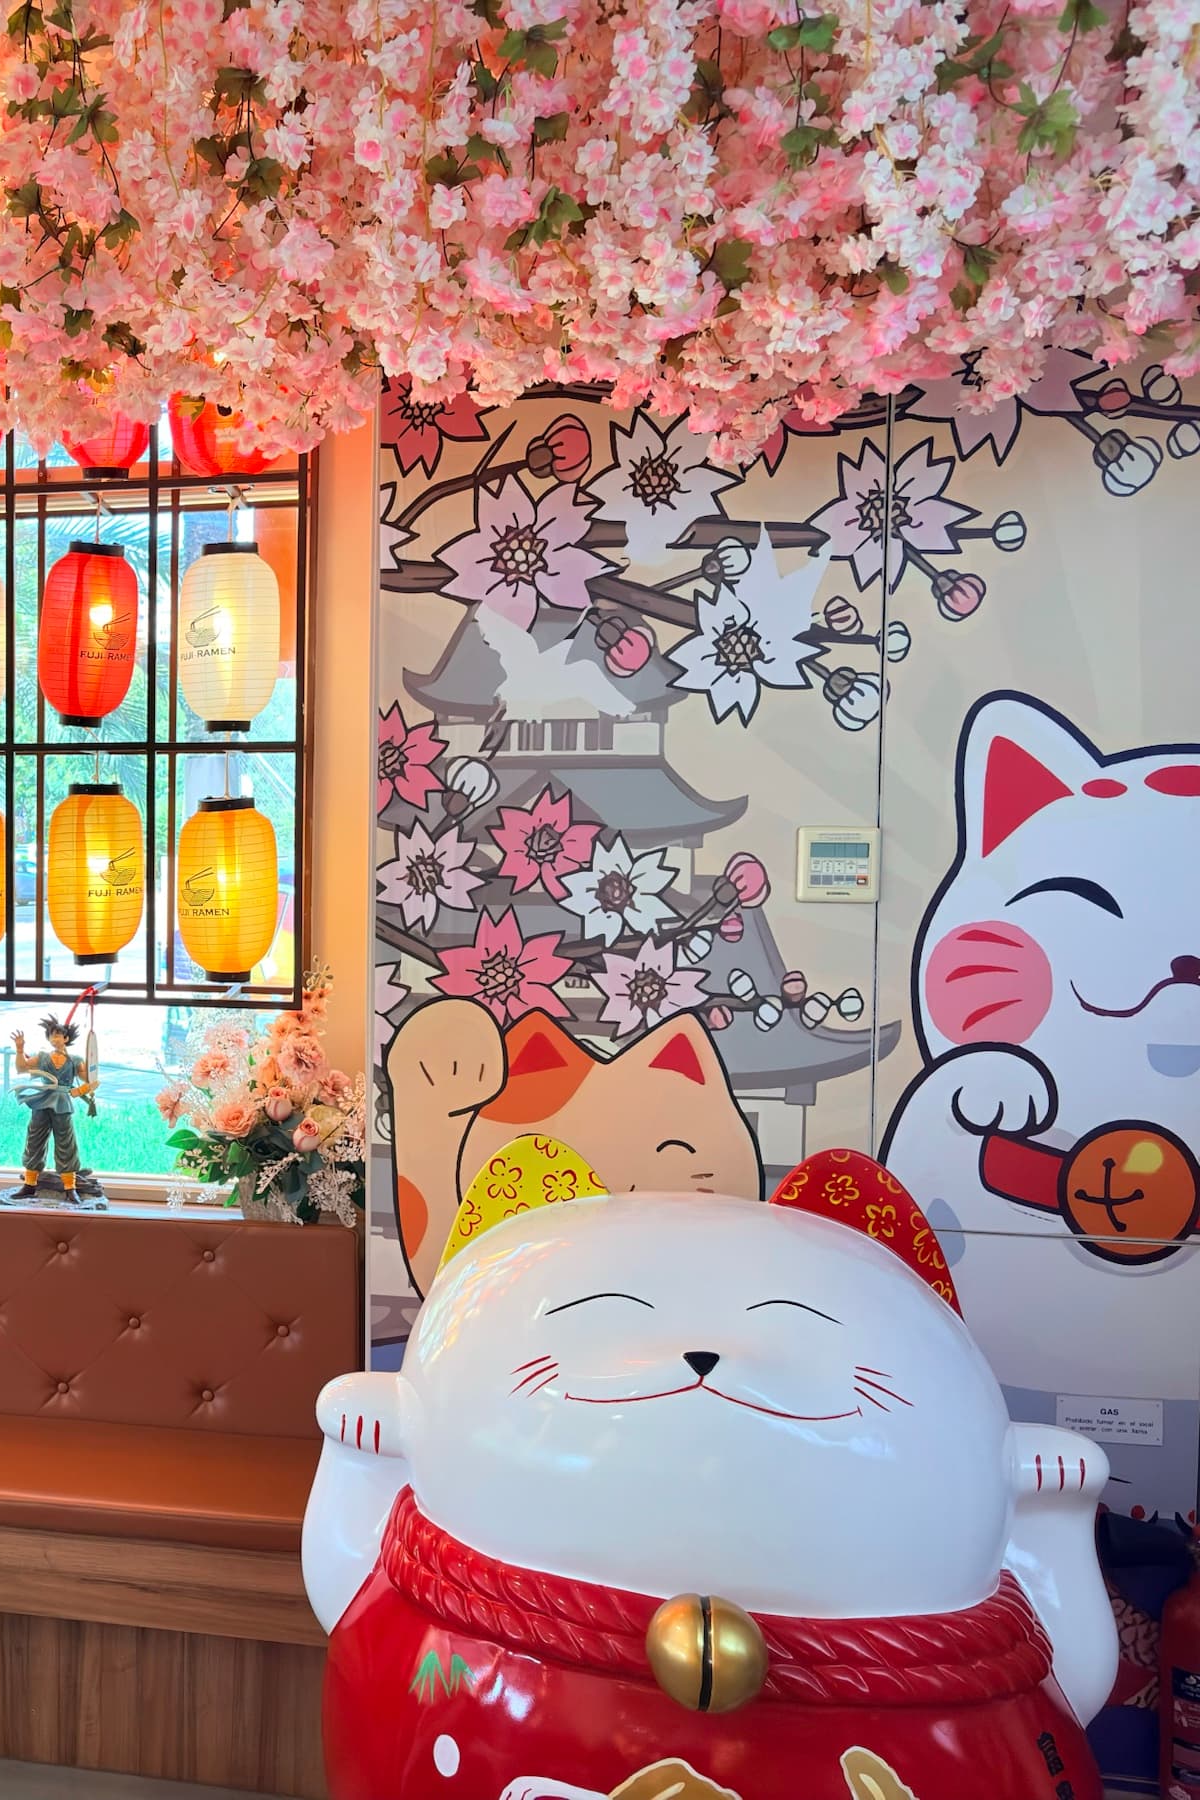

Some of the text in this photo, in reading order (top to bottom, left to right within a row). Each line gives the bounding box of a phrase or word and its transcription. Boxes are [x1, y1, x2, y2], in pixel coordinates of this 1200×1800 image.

[80, 650, 131, 662] FUJI RAME
[196, 647, 236, 658] RAMEN
[88, 888, 113, 898] FUJI
[192, 908, 230, 917] RAMEN
[1099, 1407, 1120, 1416] GAS
